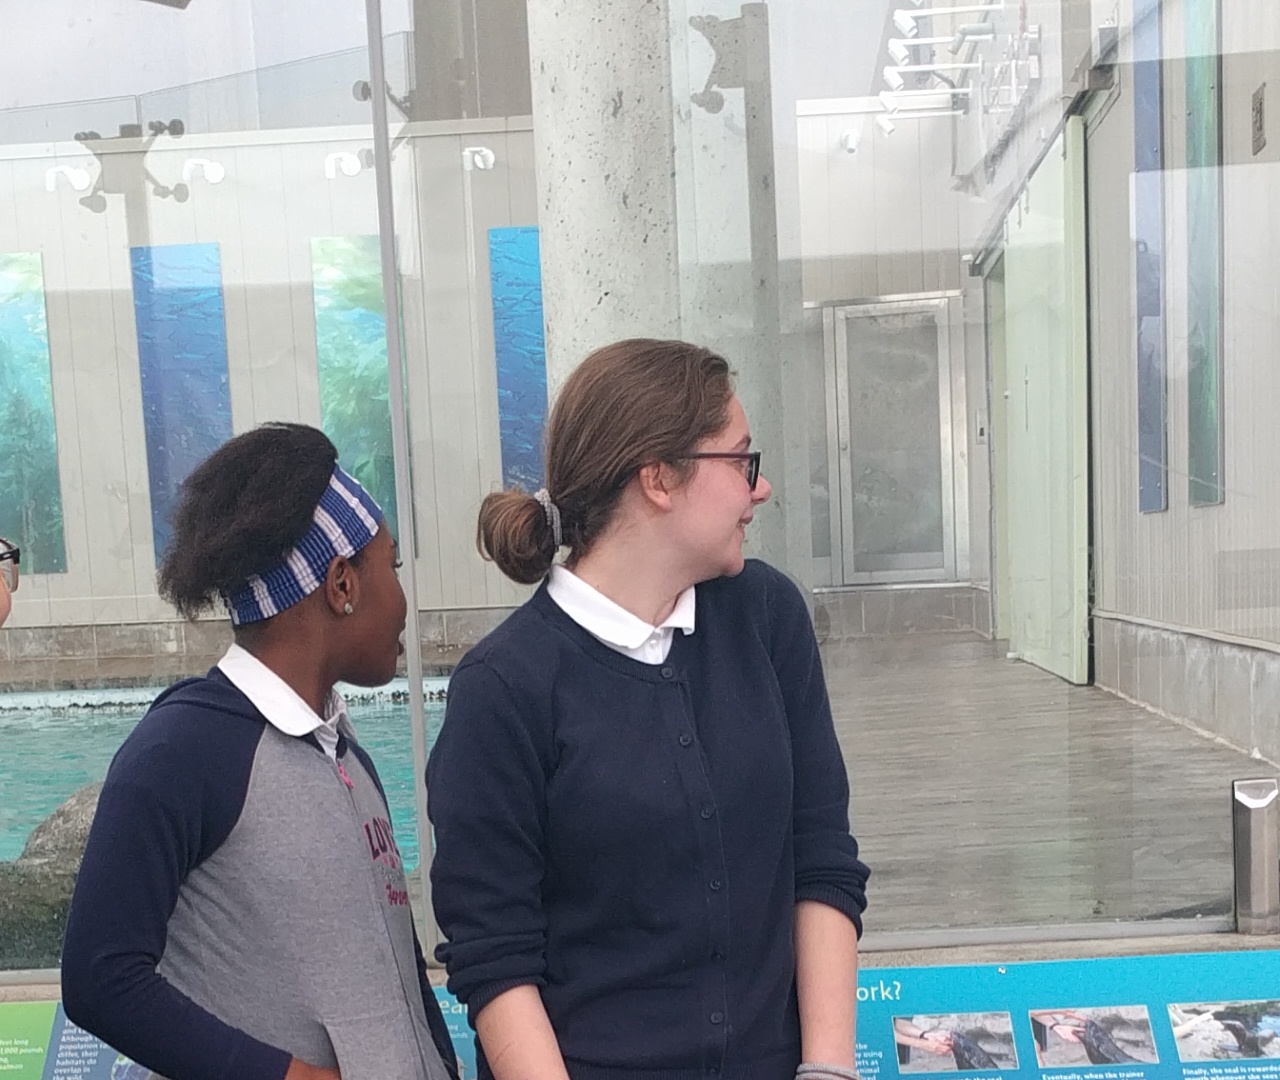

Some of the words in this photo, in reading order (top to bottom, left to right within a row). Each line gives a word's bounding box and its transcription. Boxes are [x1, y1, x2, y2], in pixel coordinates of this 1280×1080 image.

[856, 980, 900, 1001] ork?
[59, 1043, 98, 1051] population
[54, 1067, 81, 1075] overlap
